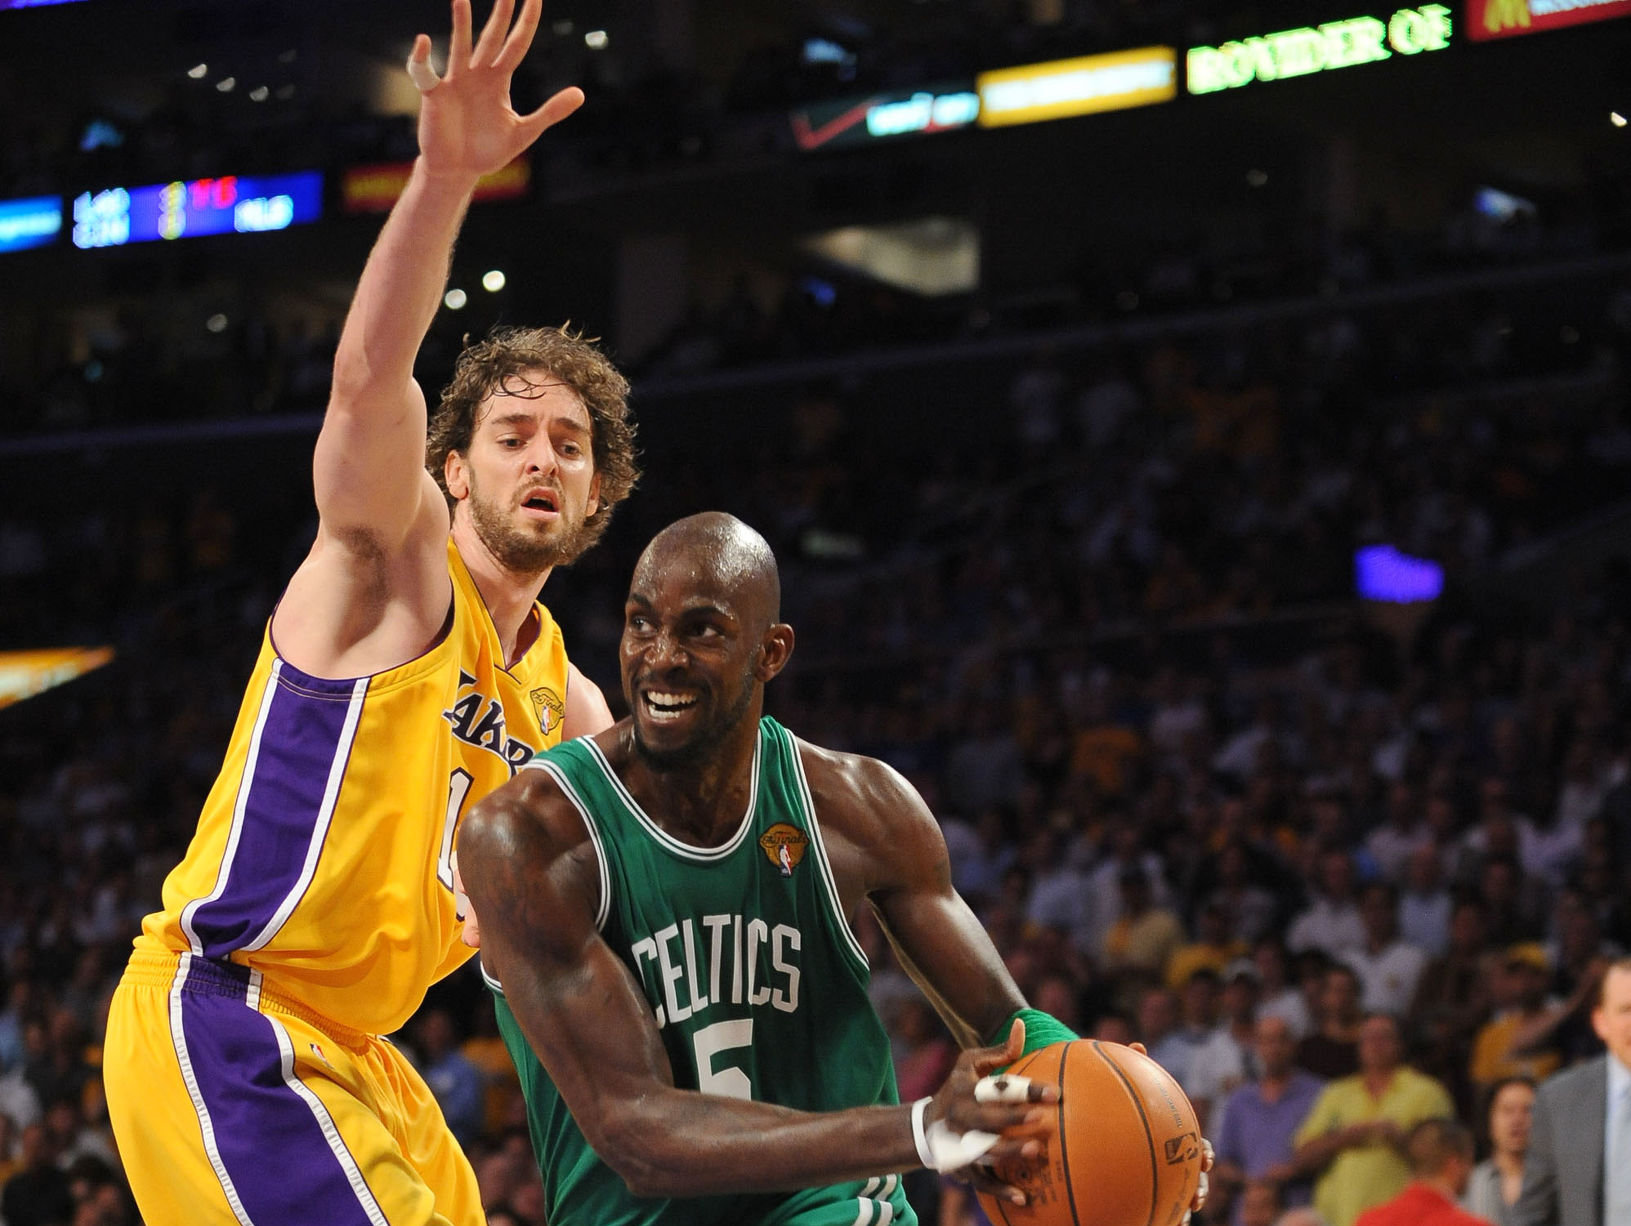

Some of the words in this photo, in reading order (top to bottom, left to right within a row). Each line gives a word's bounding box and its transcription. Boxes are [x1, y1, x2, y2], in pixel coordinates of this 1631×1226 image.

[1388, 3, 1452, 55] OF
[437, 767, 475, 922] 1
[632, 914, 801, 1029] CELTICS
[693, 1018, 753, 1101] 5
